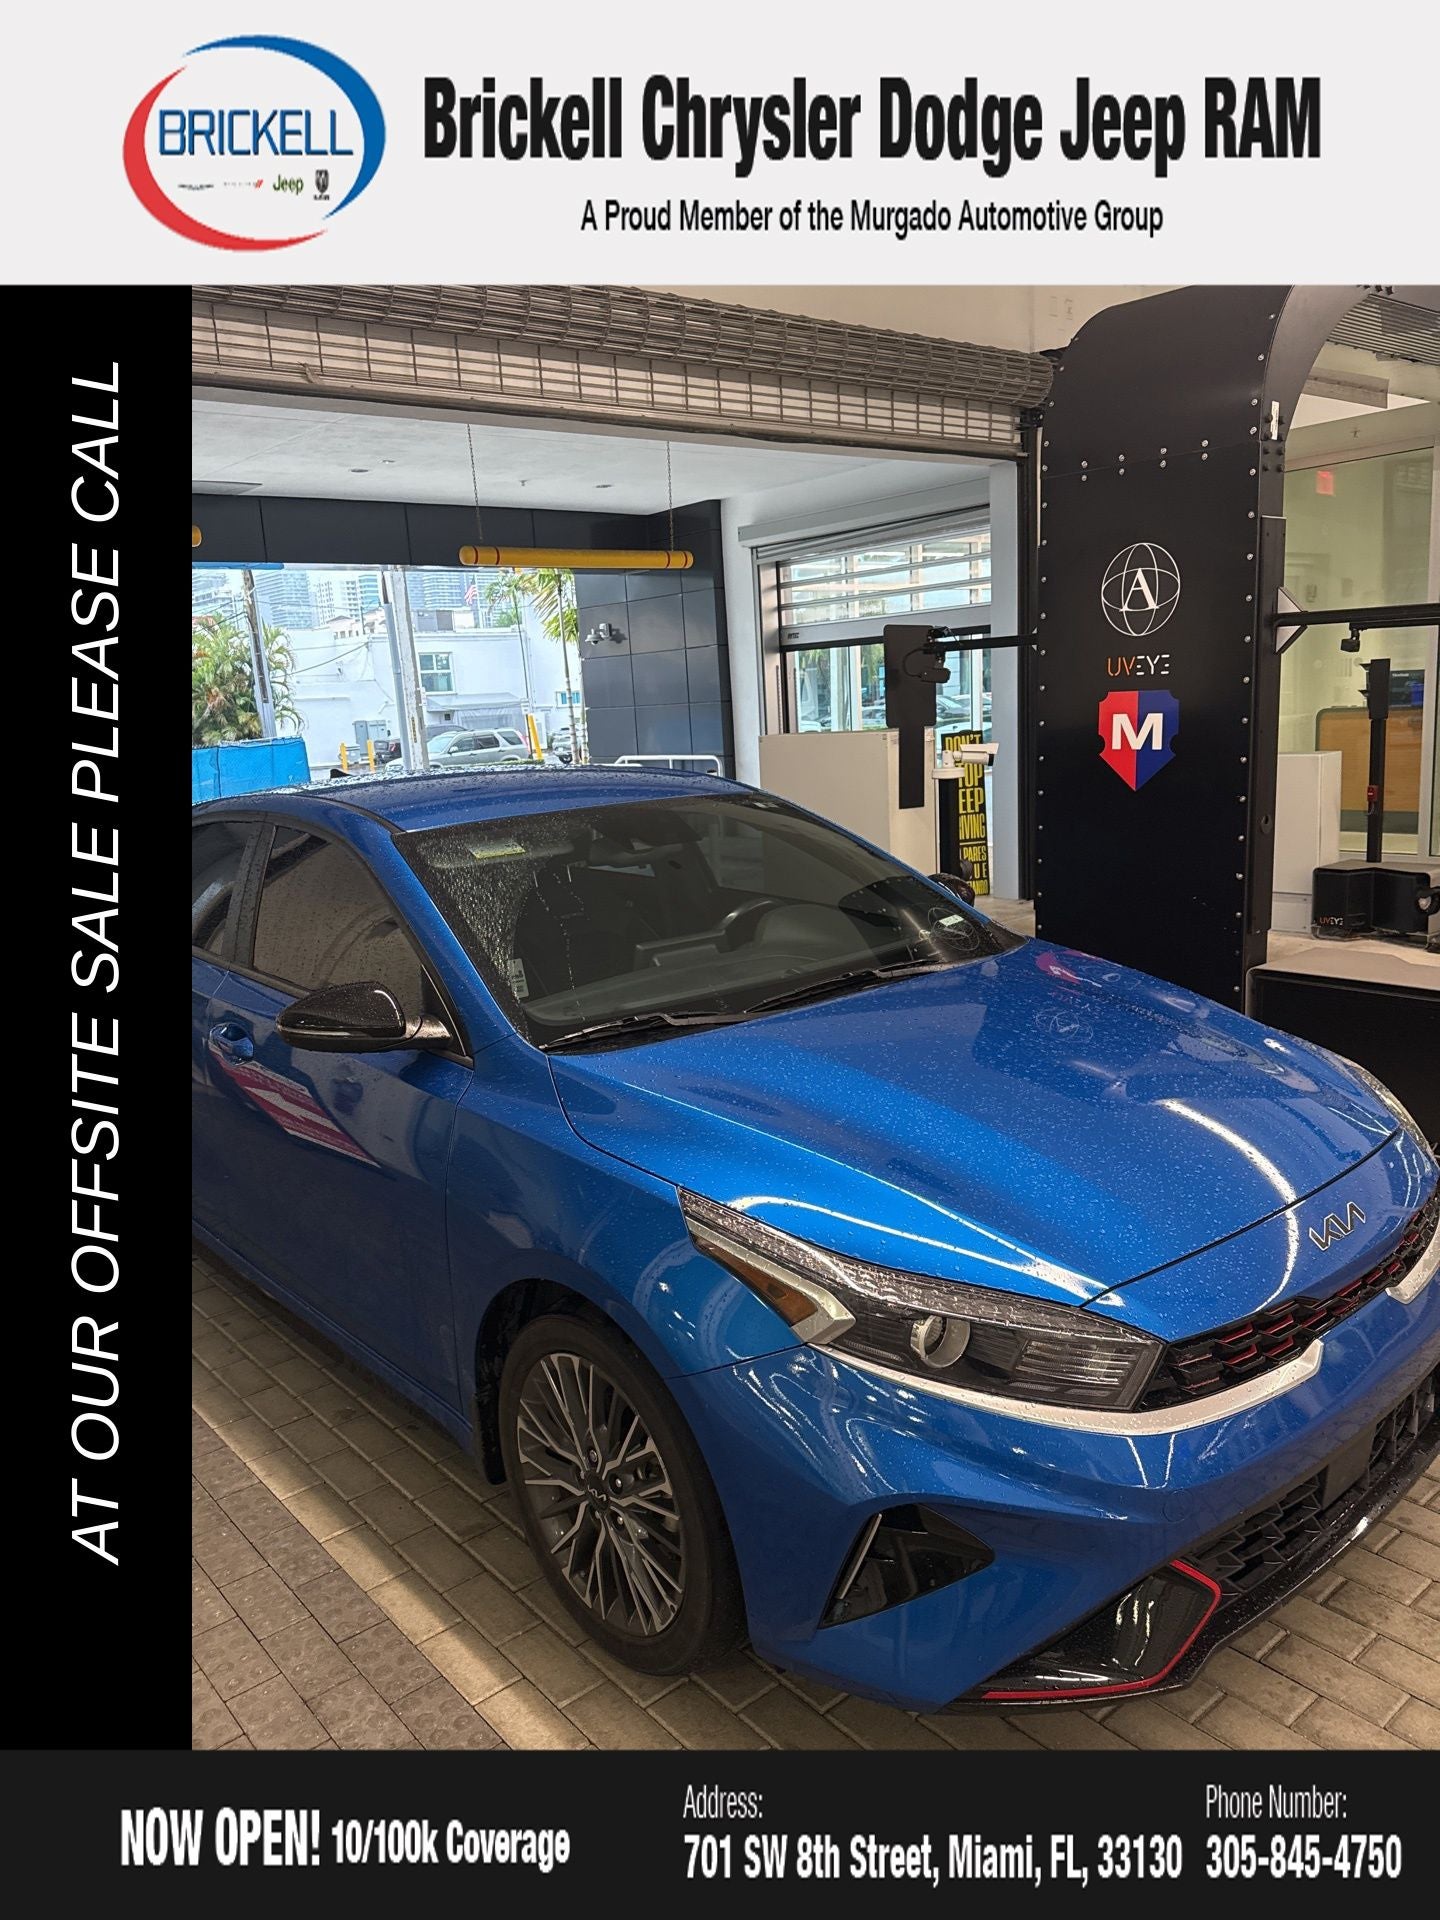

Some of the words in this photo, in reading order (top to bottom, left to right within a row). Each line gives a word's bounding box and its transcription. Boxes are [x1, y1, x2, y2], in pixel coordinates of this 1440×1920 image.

[1107, 654, 1170, 677] UVEYE
[1111, 712, 1163, 750] M
[958, 788, 984, 814] EEP
